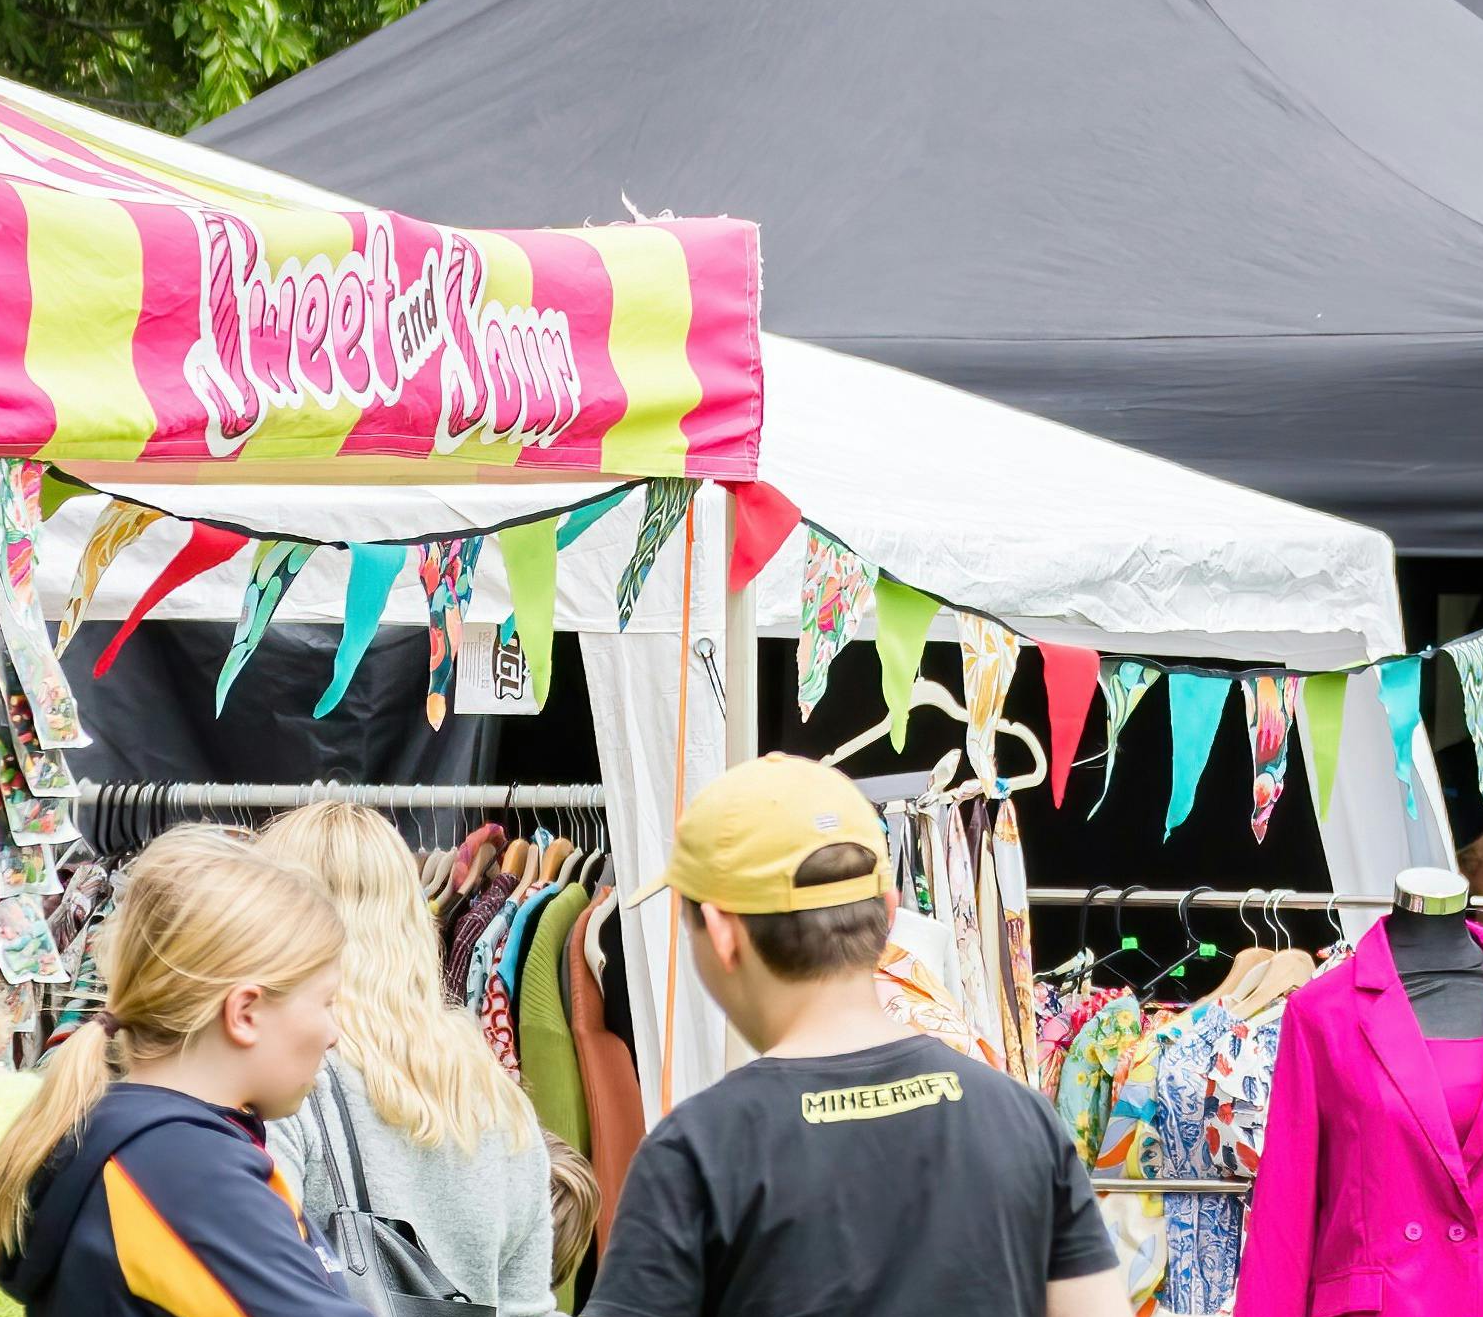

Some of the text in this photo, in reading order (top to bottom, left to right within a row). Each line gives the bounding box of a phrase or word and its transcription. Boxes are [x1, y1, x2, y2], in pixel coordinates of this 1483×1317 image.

[196, 210, 576, 439] Sweet and Sour
[803, 1074, 963, 1118] MINECRAFT
